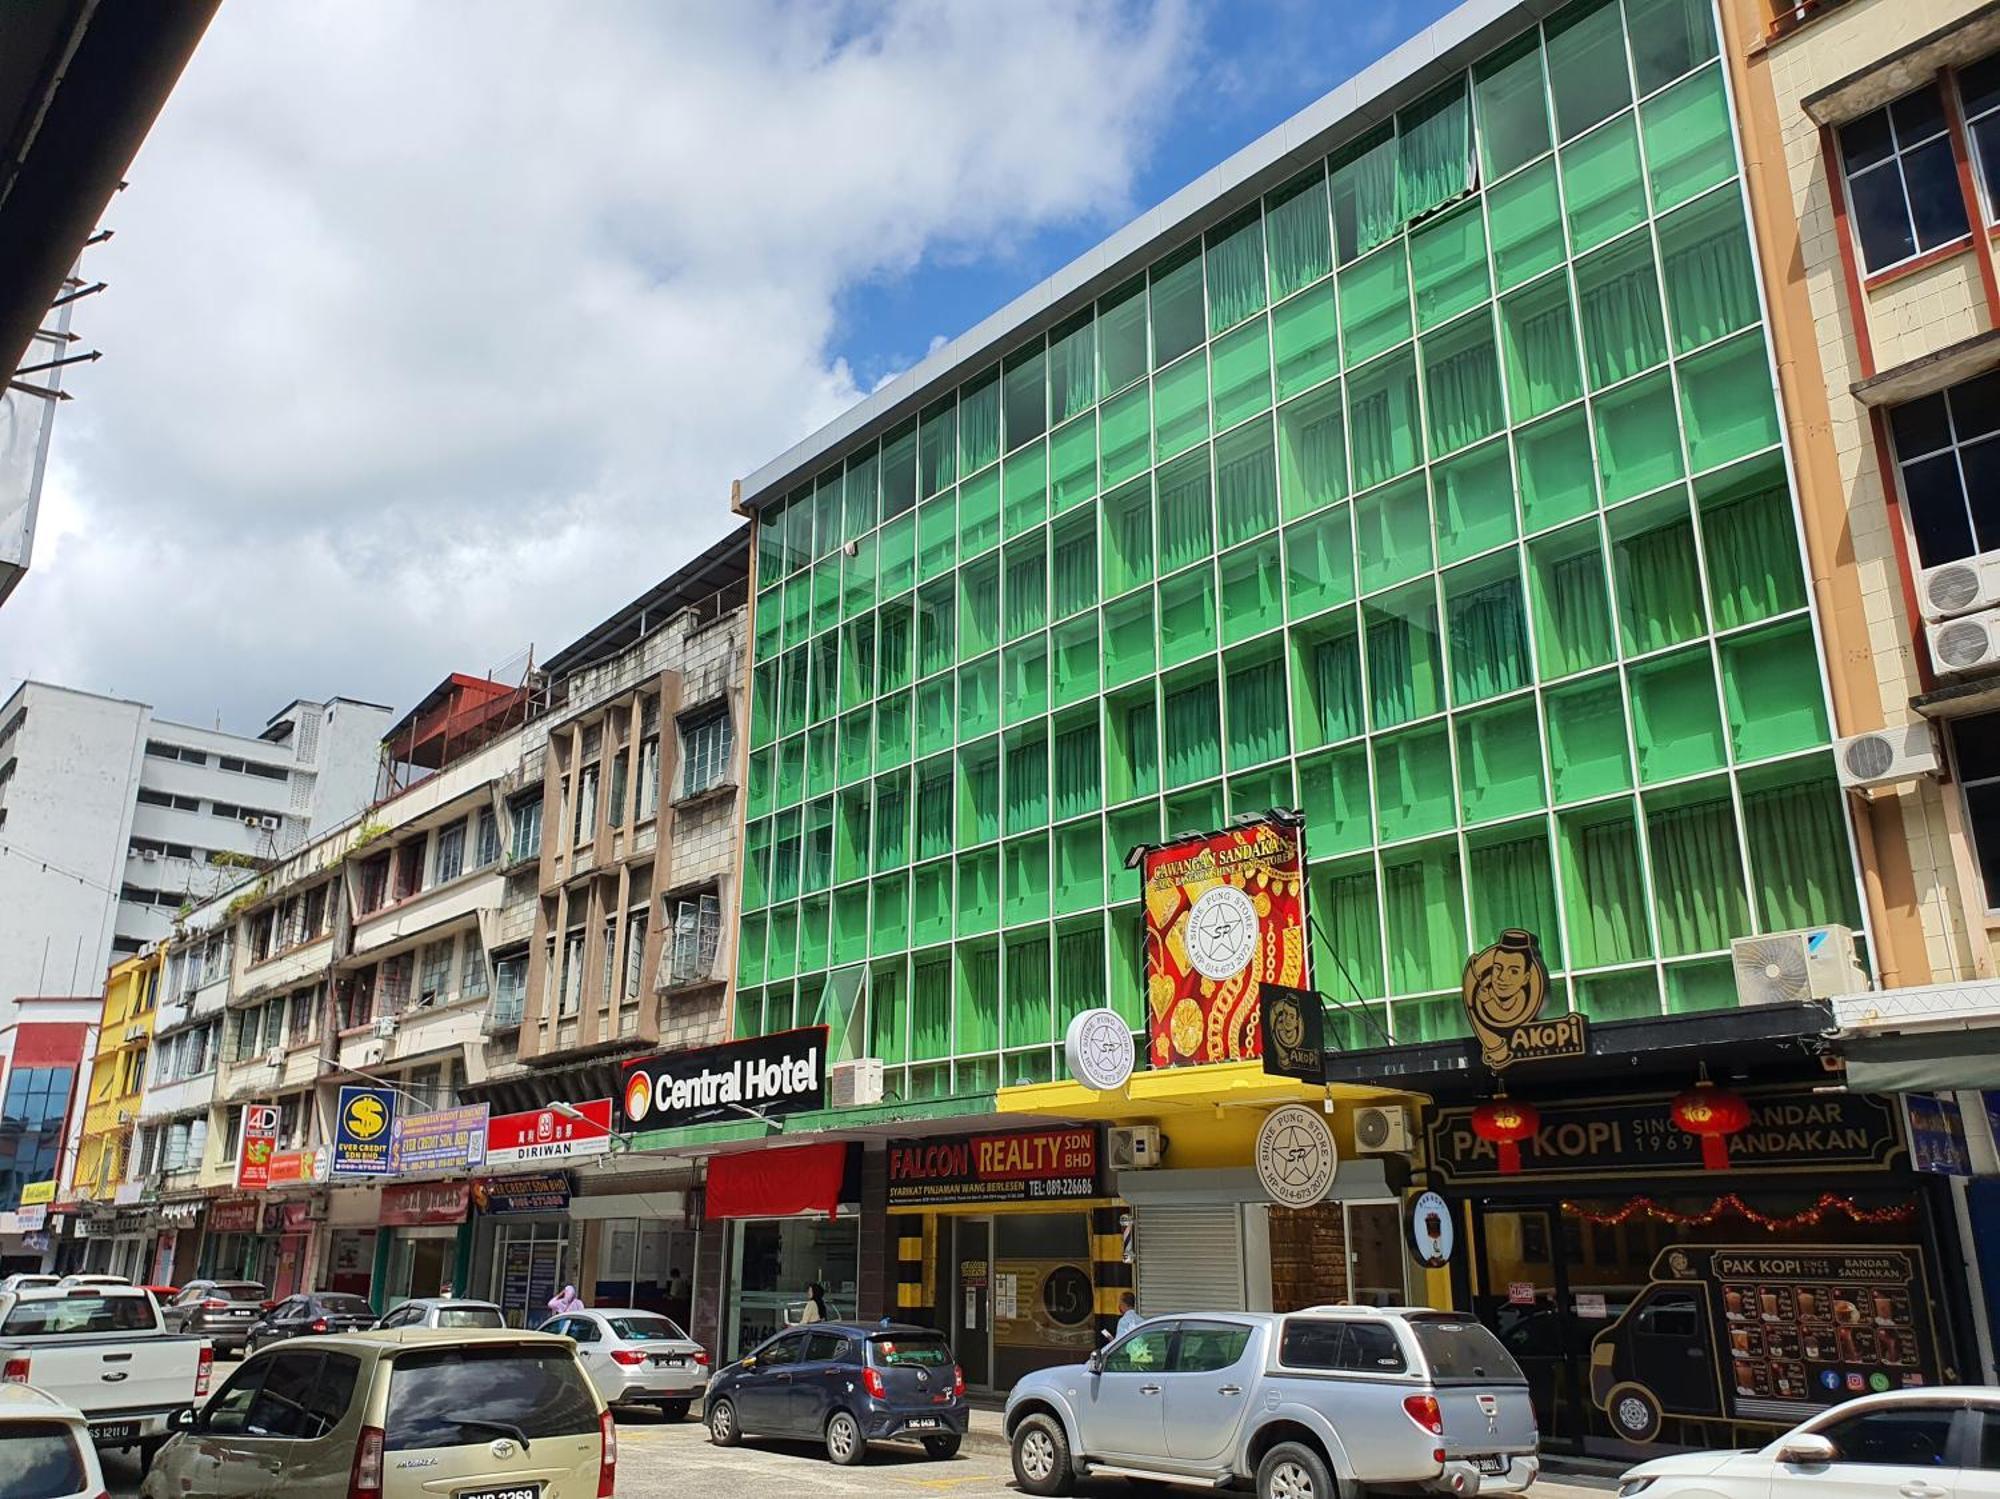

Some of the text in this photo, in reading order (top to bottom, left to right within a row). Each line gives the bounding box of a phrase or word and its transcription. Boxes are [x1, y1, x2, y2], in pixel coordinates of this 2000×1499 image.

[1219, 836, 1289, 865] SANDAKAN
[1206, 891, 1231, 905] PUNG
[1234, 897, 1254, 930] STORE
[654, 1046, 818, 1112] Central Hotel
[249, 1108, 277, 1129] 4D
[1748, 1103, 1844, 1127] ANDAR
[1064, 1134, 1091, 1150] SDN
[1262, 1113, 1329, 1161] SHINE PUNG STORE
[1533, 1120, 1622, 1157] KOPI
[1634, 1135, 1694, 1152] 1969
[1729, 1128, 1868, 1154] ANDAKAN
[518, 1143, 572, 1159] DIRIWAN
[890, 1136, 1063, 1180] FALCON REALTY
[1064, 1153, 1092, 1169] BHD
[889, 1186, 923, 1197] SYARIKAT
[924, 1184, 961, 1196] PINJAMAN
[962, 1182, 986, 1194] WANG
[1723, 1259, 1800, 1274] PAK KOPI
[1838, 1268, 1900, 1278] SANDAKAN
[1844, 1259, 1891, 1268] BANDAR
